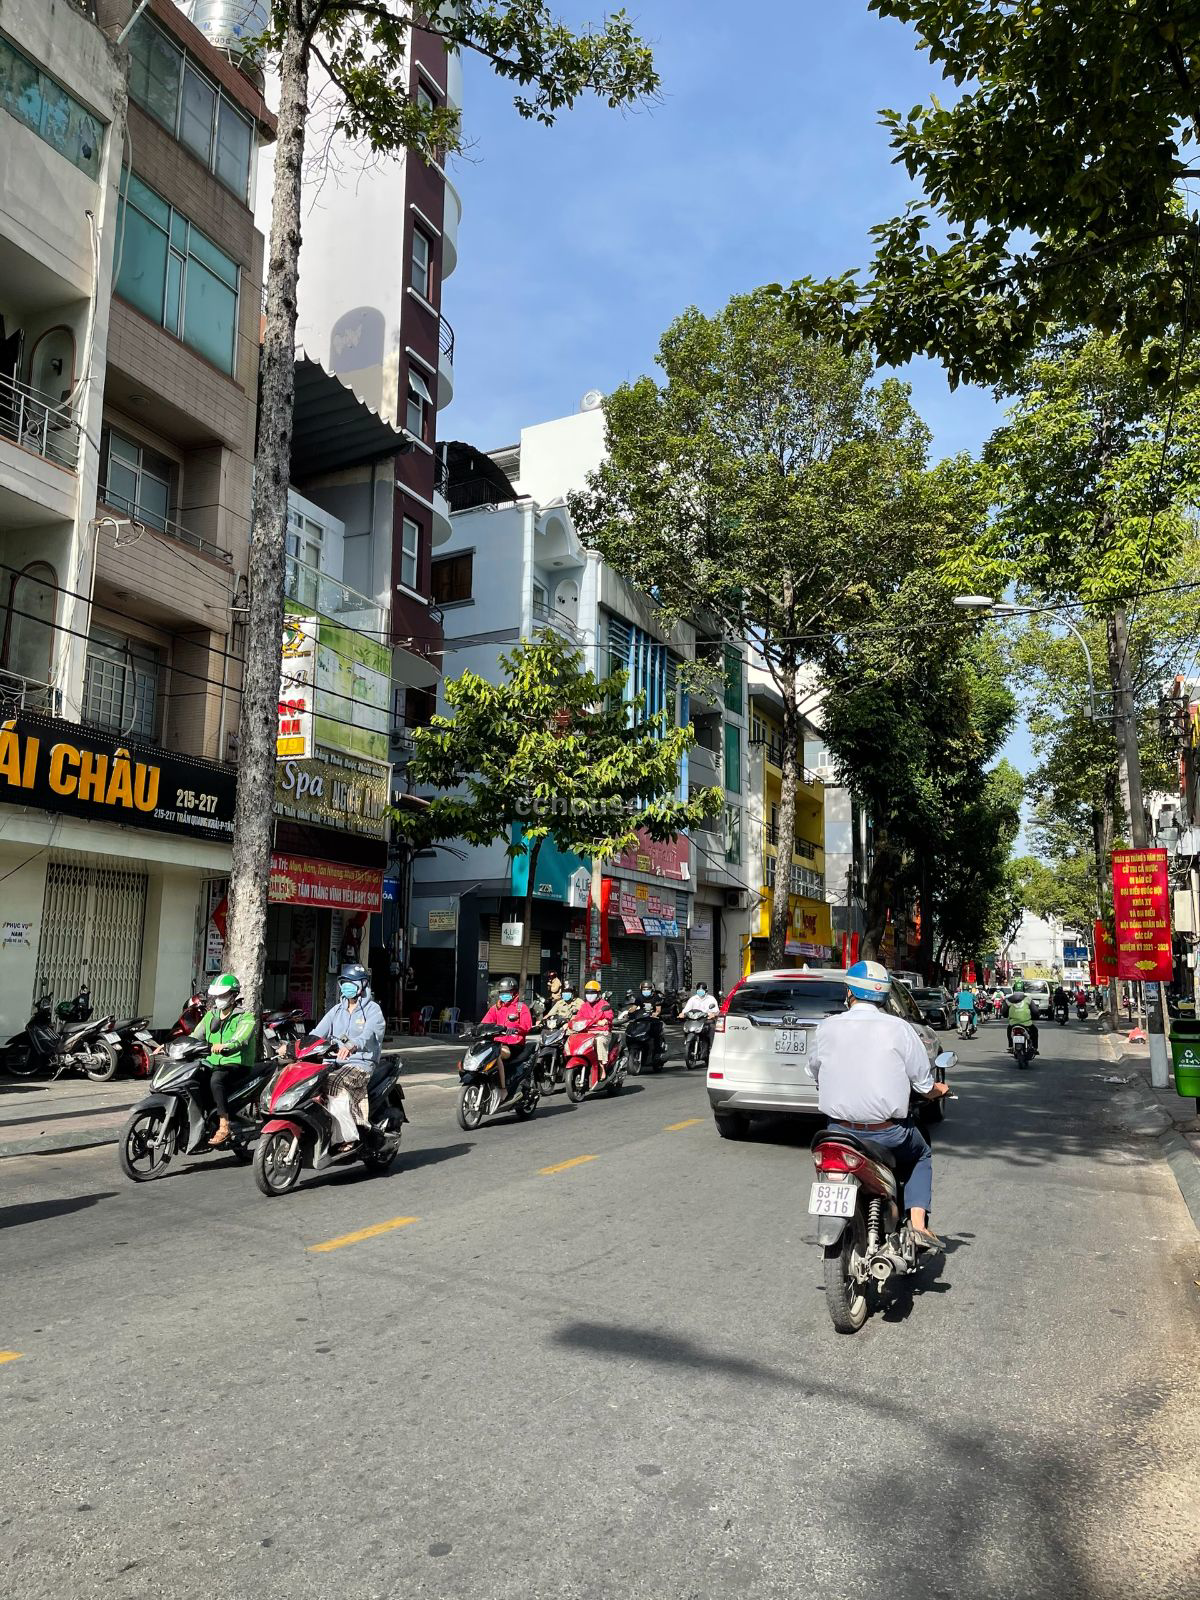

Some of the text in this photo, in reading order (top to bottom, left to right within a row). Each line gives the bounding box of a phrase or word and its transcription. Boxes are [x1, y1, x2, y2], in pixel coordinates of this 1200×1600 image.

[49, 743, 161, 812] CHÂU
[281, 760, 324, 799] Spa
[176, 788, 219, 813] 215-217
[153, 808, 176, 821] 215-217
[782, 1031, 799, 1041] 51F
[817, 1185, 850, 1200] 63-H7
[816, 1199, 849, 1214] 7316
